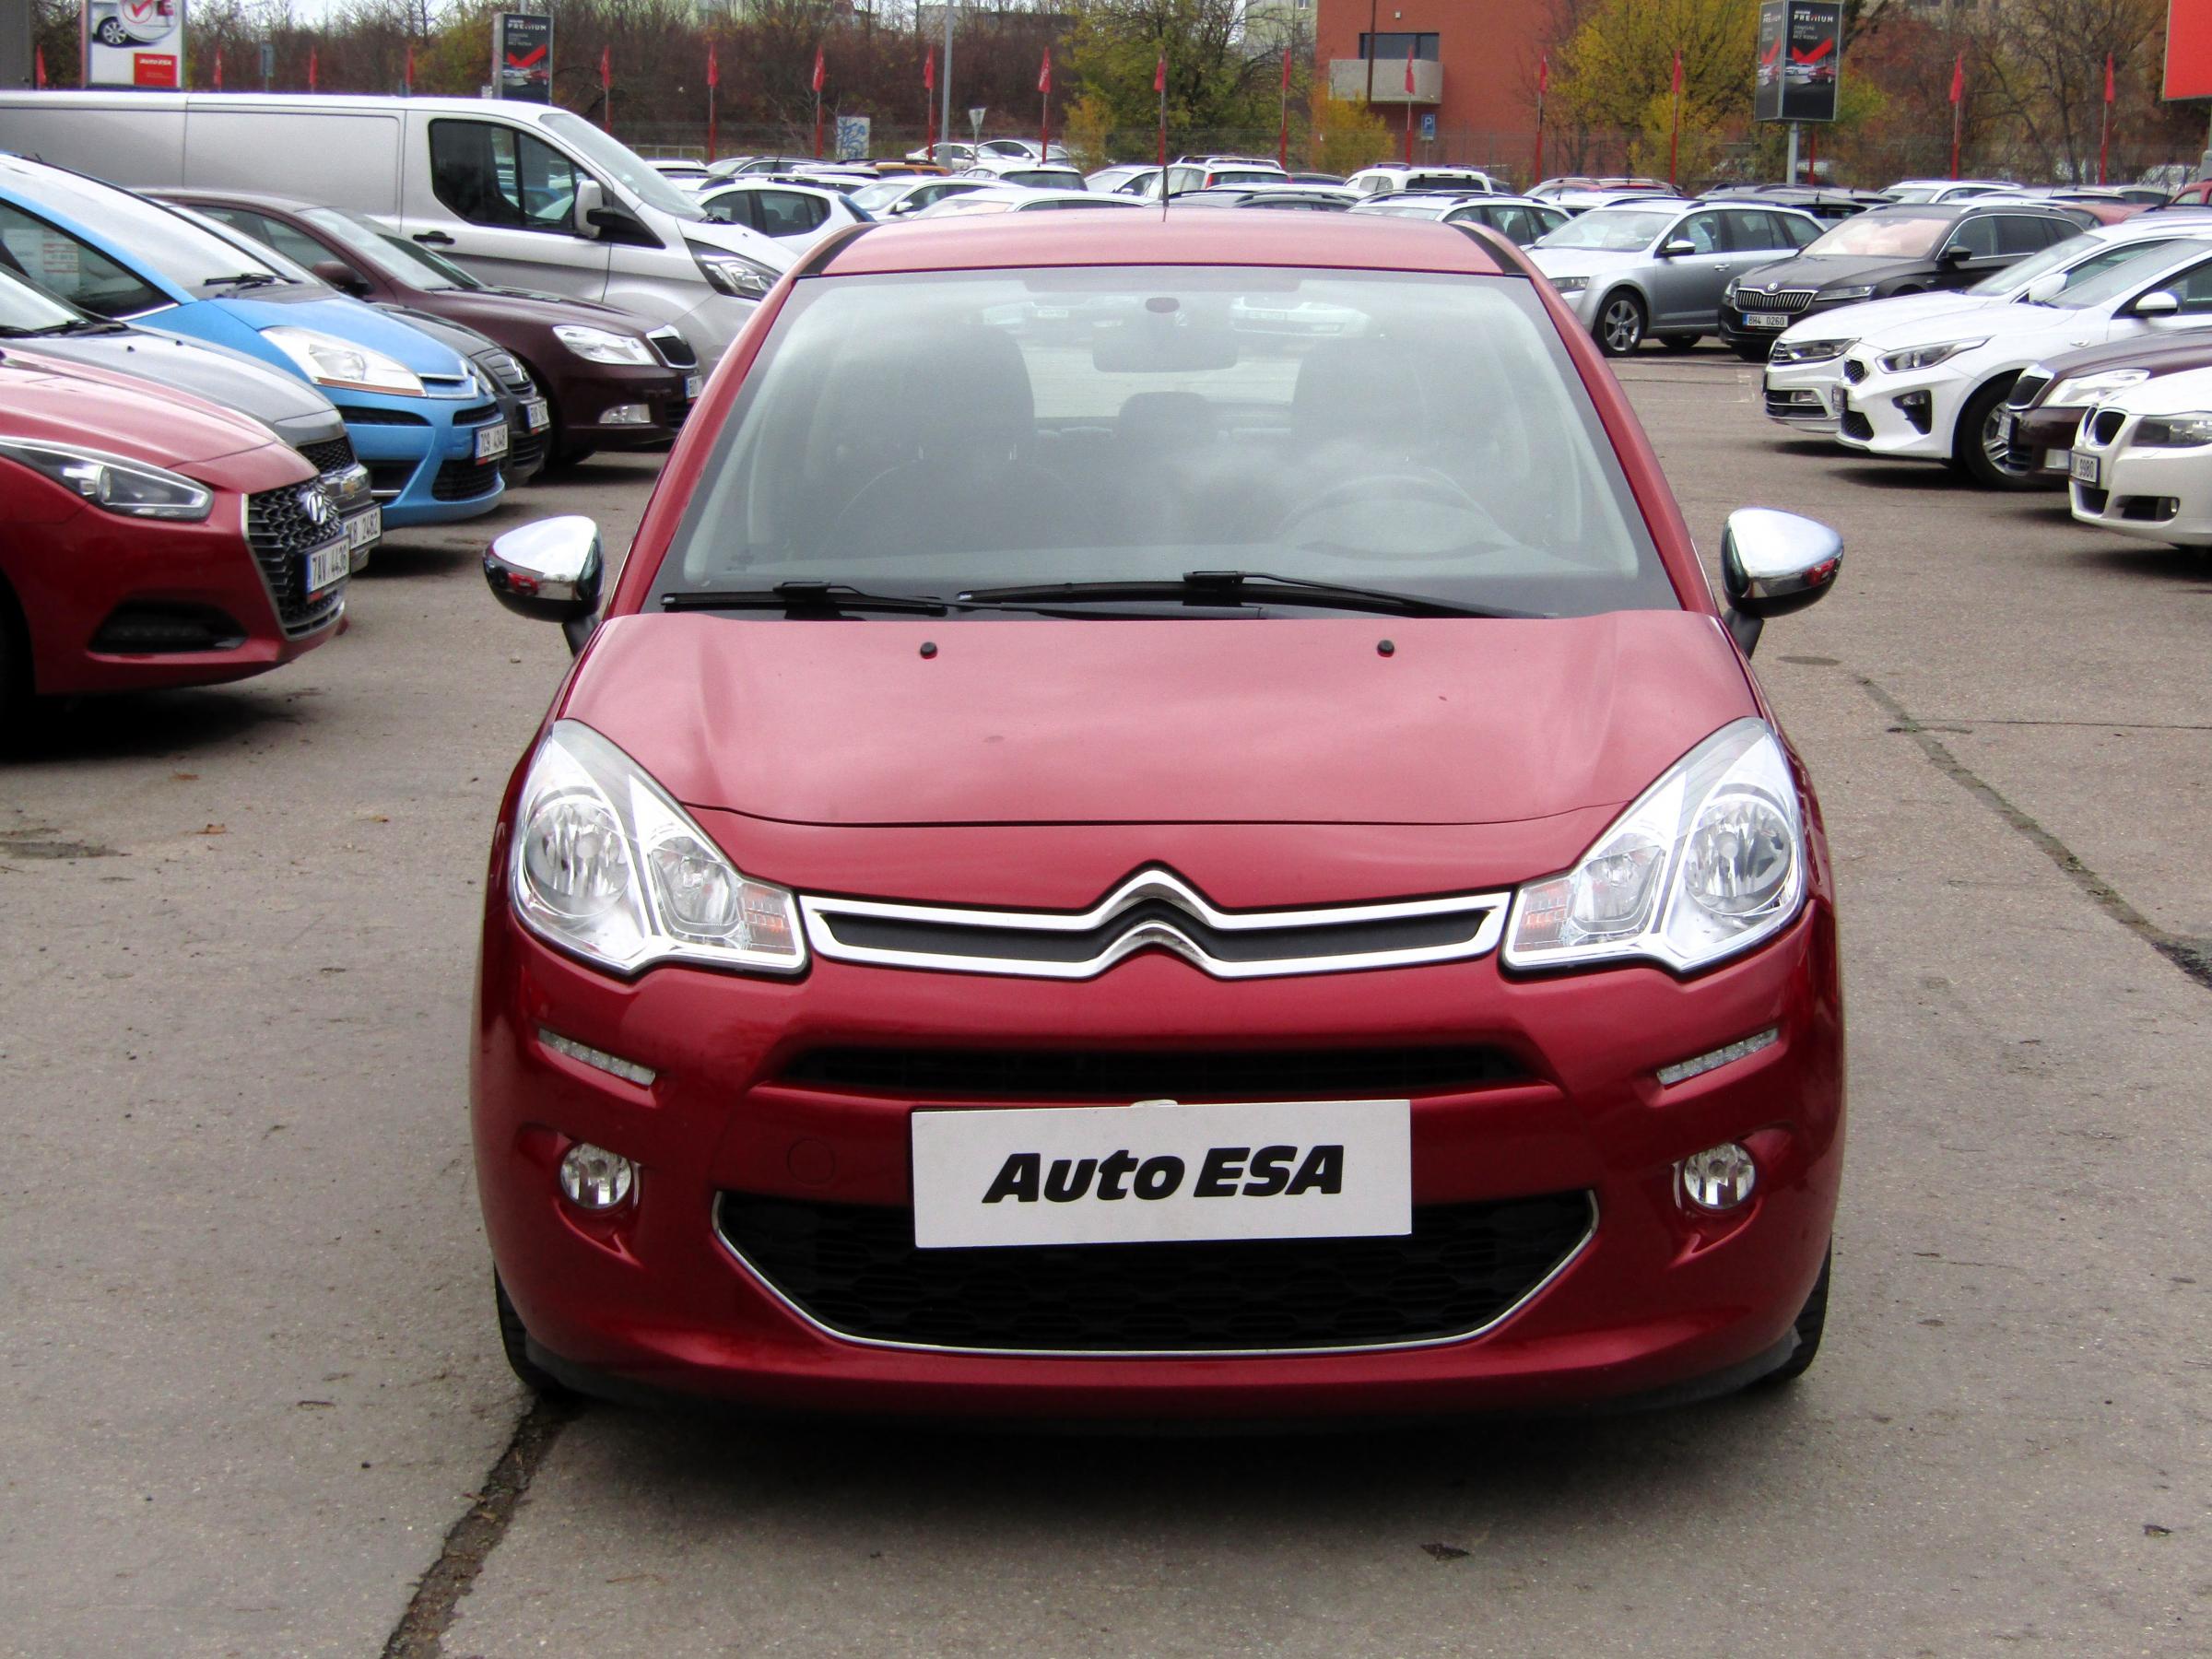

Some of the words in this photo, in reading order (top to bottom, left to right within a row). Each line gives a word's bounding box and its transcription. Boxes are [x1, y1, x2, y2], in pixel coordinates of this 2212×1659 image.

[1766, 317, 1784, 326] 0260
[982, 1149, 1185, 1204] Auto
[1194, 1145, 1344, 1197] ESA
